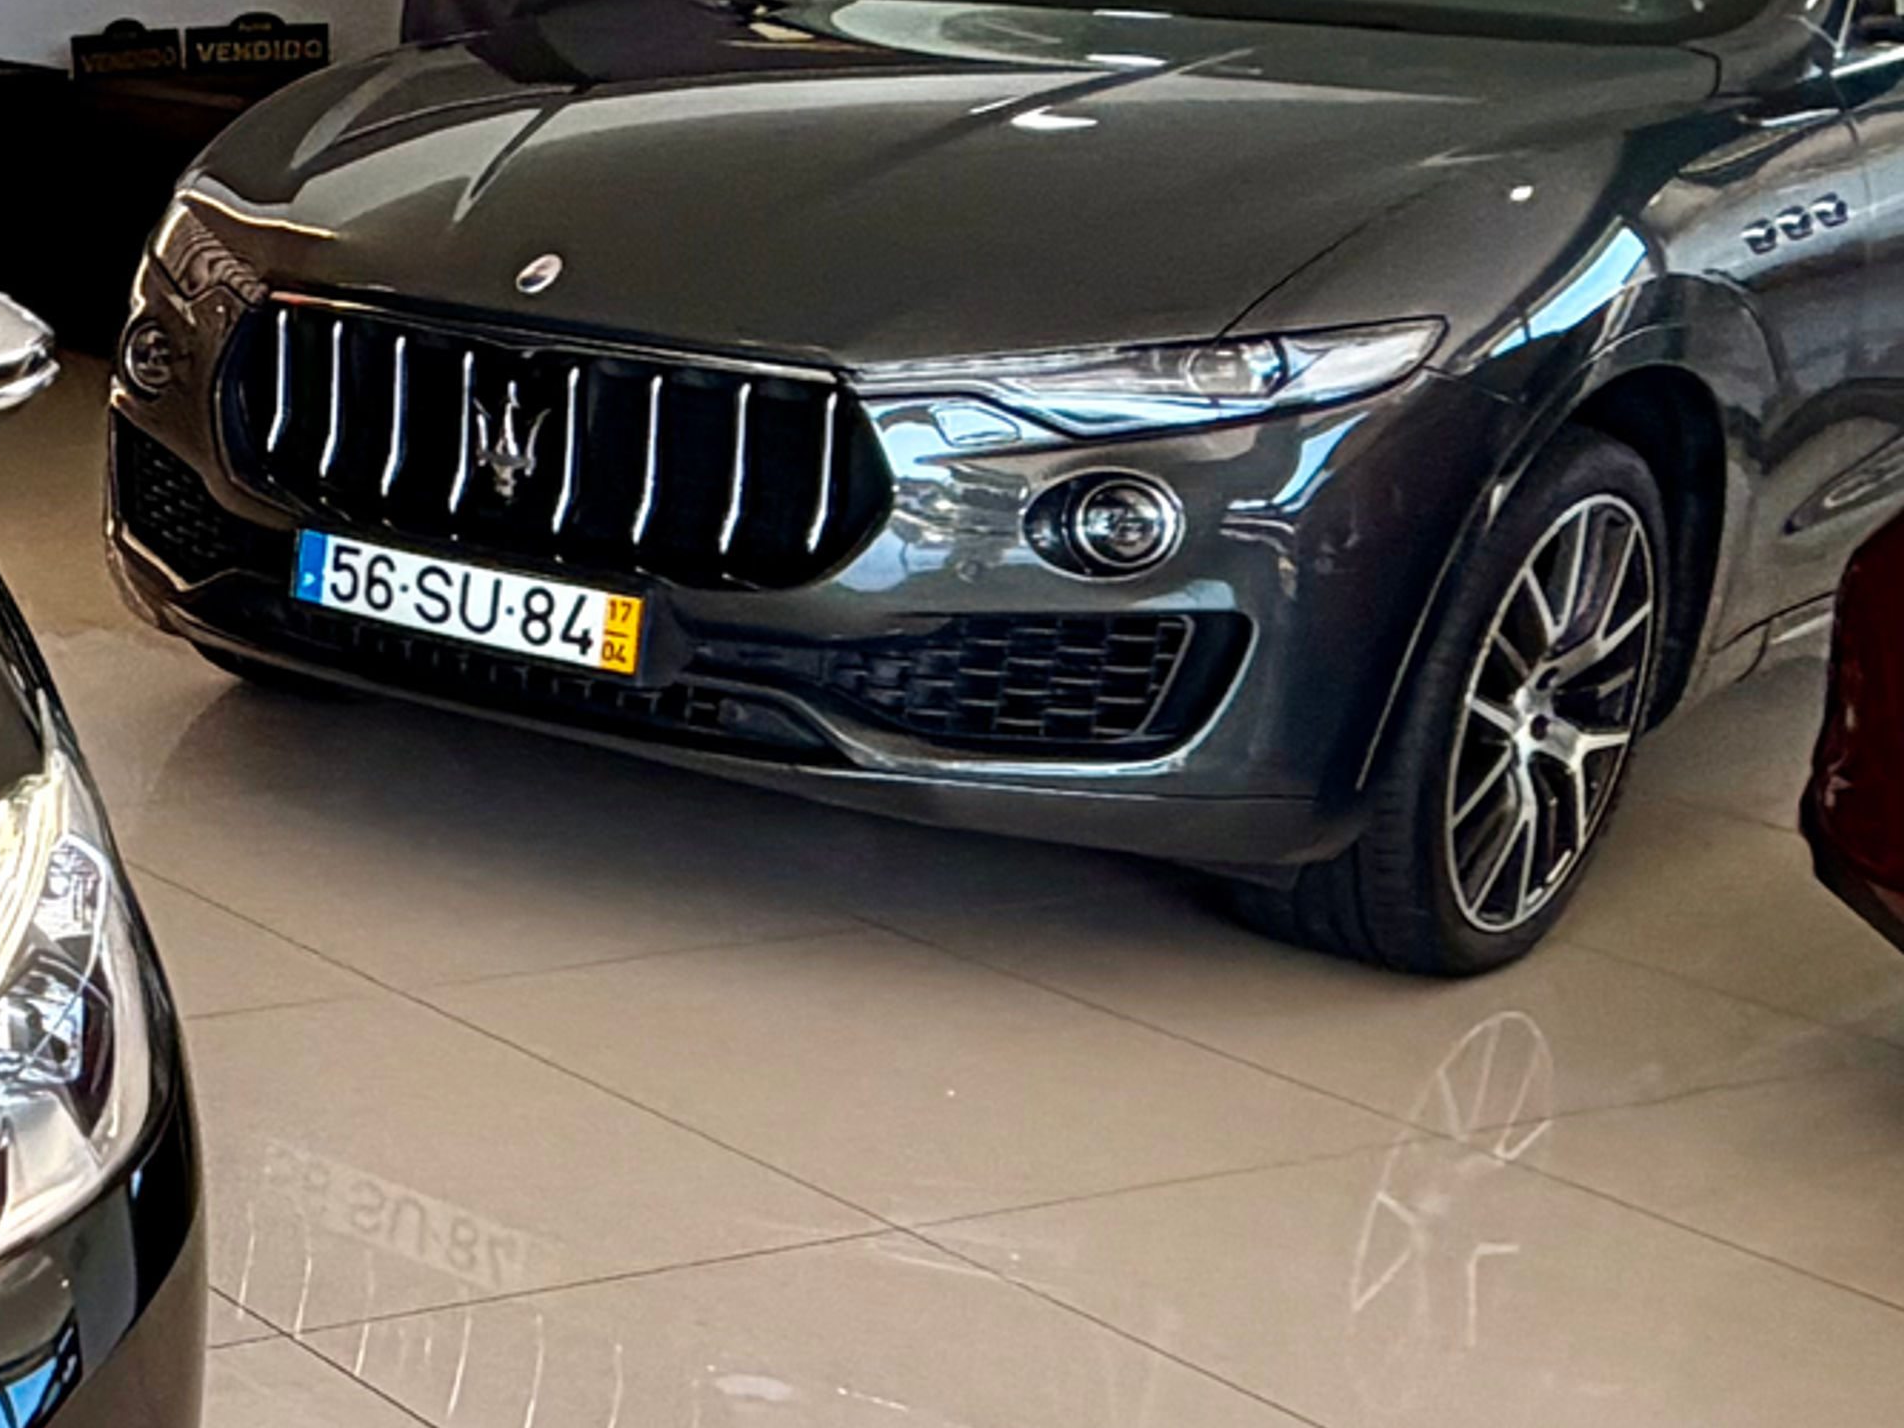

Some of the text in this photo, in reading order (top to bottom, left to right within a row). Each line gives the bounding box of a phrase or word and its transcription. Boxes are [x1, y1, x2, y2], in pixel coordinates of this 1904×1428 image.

[195, 39, 324, 63] VENDIDO
[609, 599, 633, 623] 17
[601, 639, 627, 665] 04
